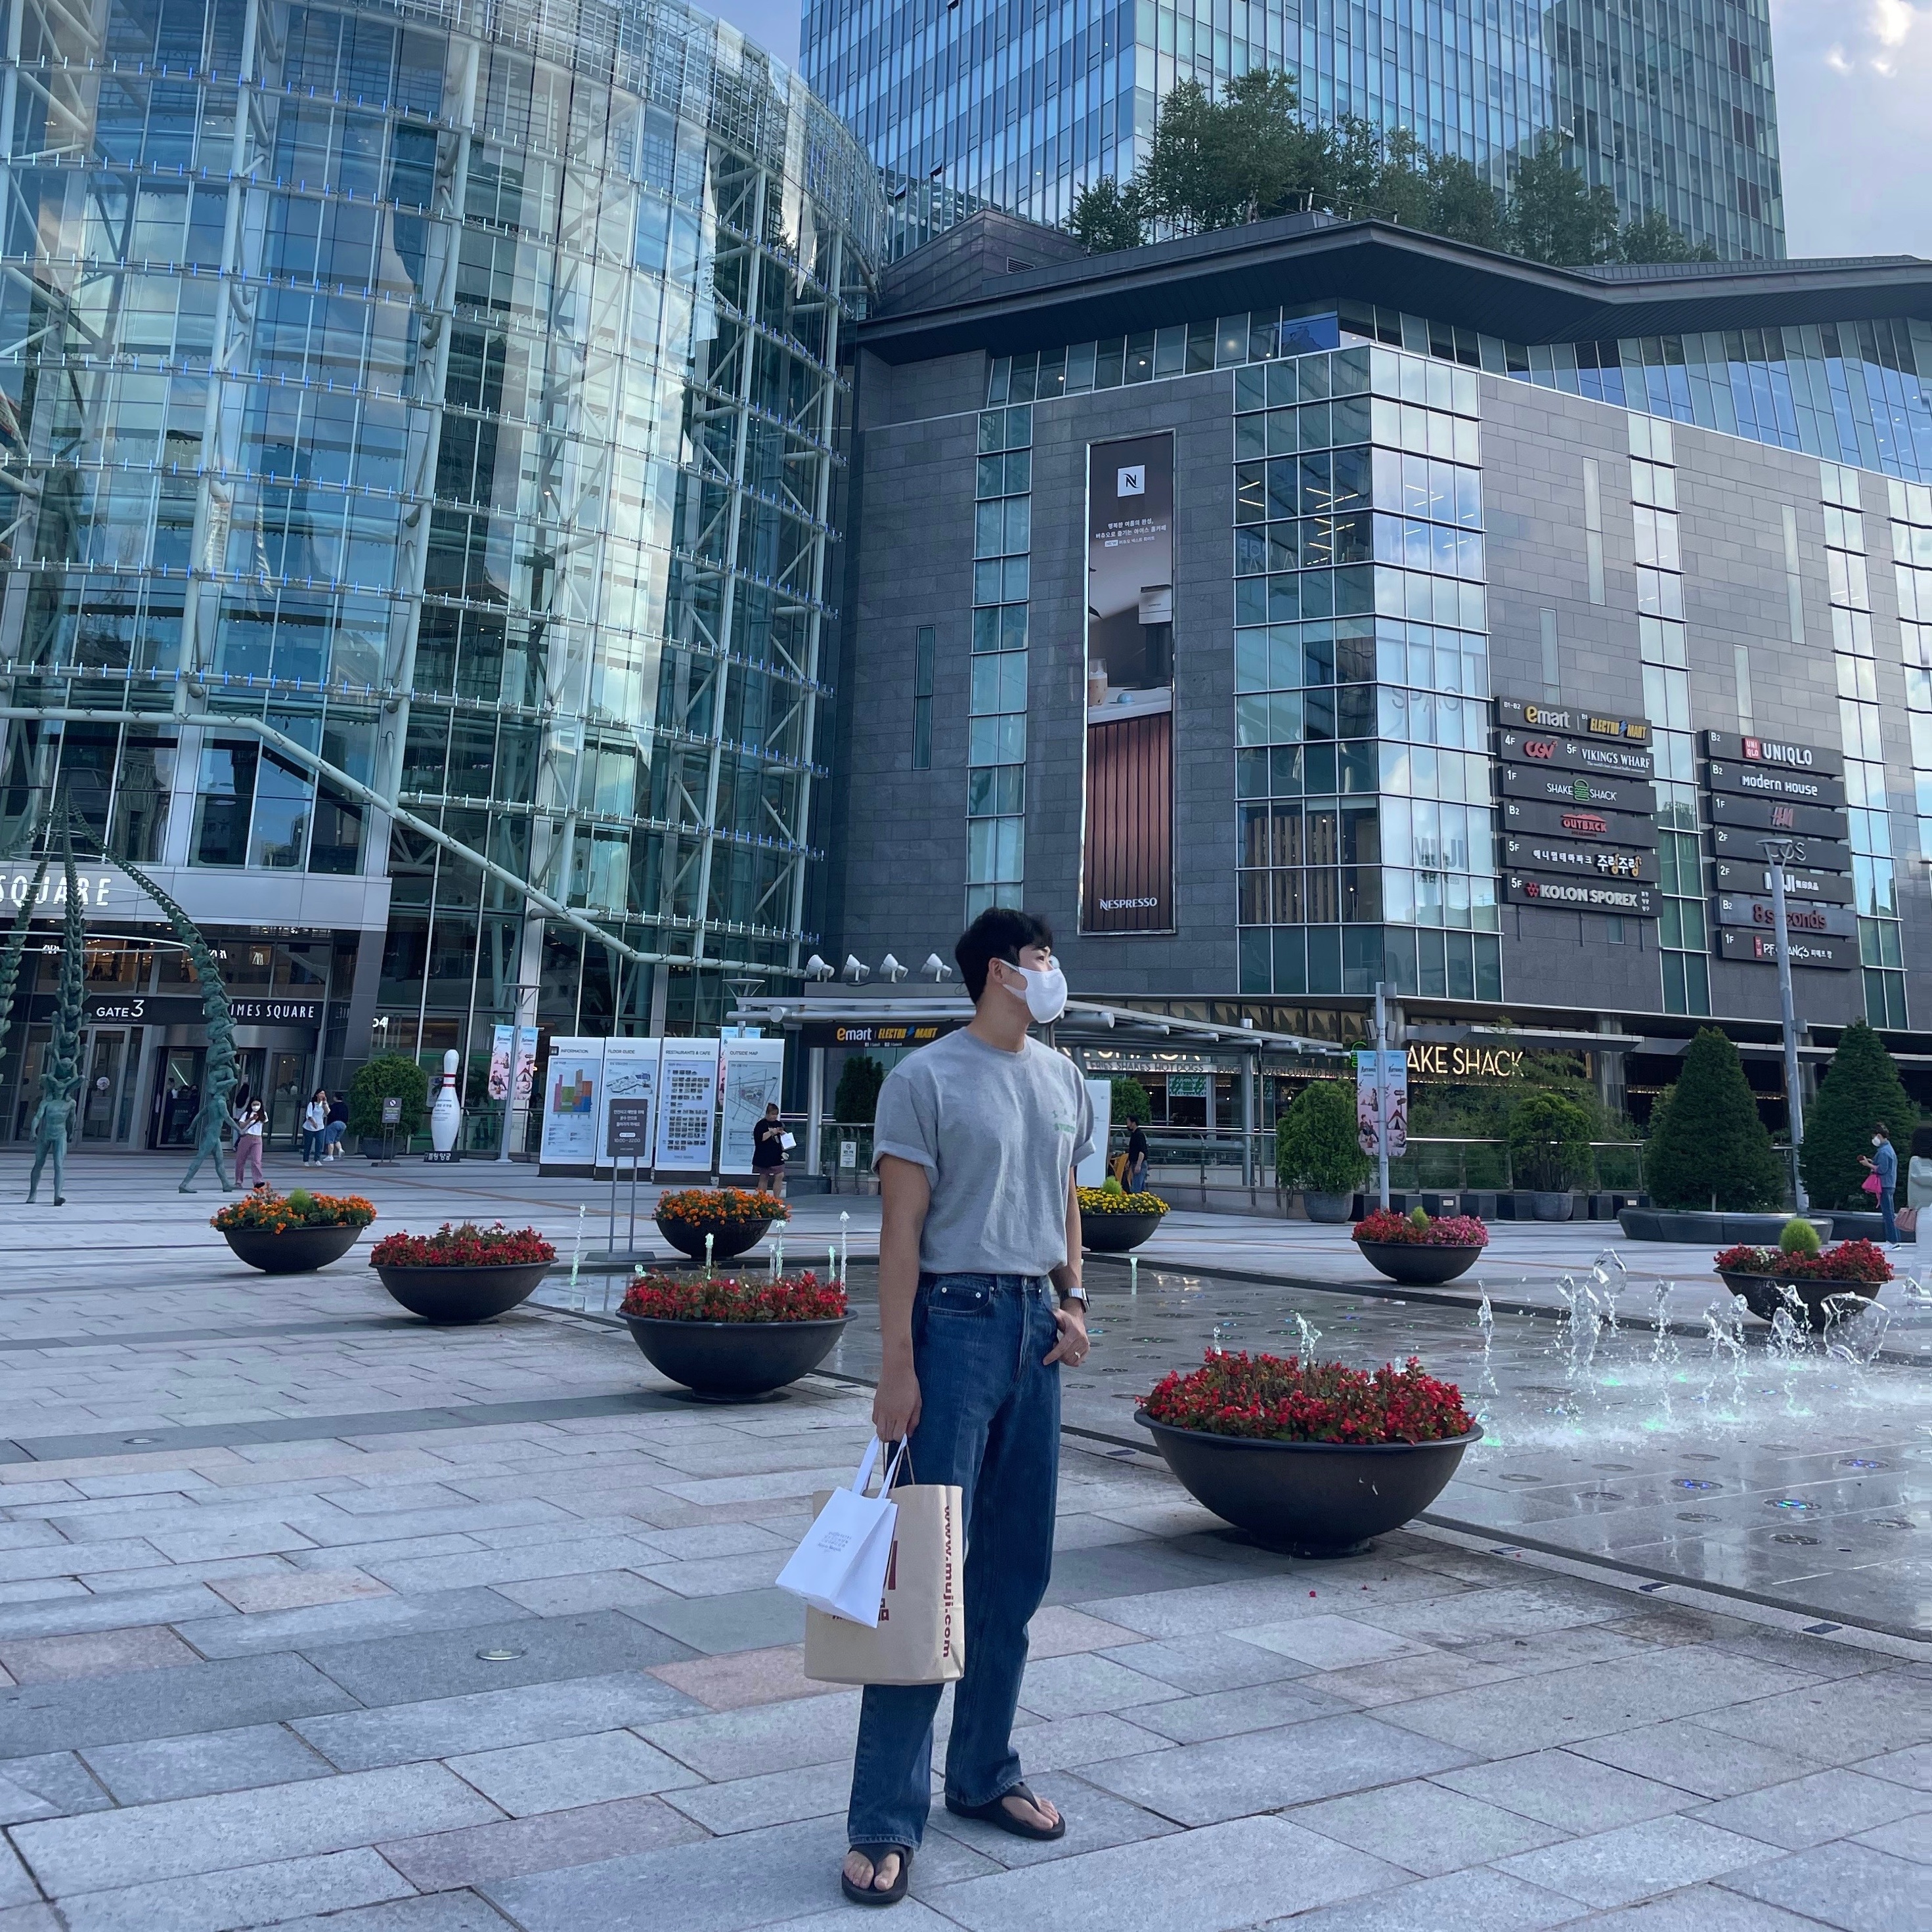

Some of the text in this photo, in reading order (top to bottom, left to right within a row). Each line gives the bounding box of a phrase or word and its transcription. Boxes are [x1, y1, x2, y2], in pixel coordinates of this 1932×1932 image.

[1526, 705, 1571, 728] emart
[1589, 718, 1647, 739] ELECTRO MART
[1504, 735, 1516, 745] 4F
[1711, 732, 1721, 741] B2
[1525, 741, 1556, 758] CGV
[1566, 743, 1577, 754] 5F
[1747, 740, 1757, 749] UNI
[1581, 749, 1619, 764] VIKING'S
[1619, 754, 1650, 768] WHARF
[1747, 749, 1759, 757] QLO
[1762, 743, 1812, 766] UNIQLO
[1507, 770, 1516, 780] 1F
[1713, 765, 1723, 775] B2
[1547, 783, 1617, 801] SHAKE SHACK
[1716, 798, 1725, 808] 1F
[1509, 805, 1520, 815] B2
[1563, 820, 1607, 833] OUTBACK
[1718, 831, 1728, 841] 2F
[1413, 837, 1465, 868] MUJI
[1509, 841, 1520, 852] 5F
[1597, 853, 1642, 877] 주렁주렁
[1720, 865, 1730, 876] 2F
[1511, 877, 1522, 889] 5F
[1763, 872, 1795, 892] MJI
[1539, 885, 1589, 902] KOLON
[1589, 889, 1638, 907] SPOREX
[1098, 897, 1158, 911] NESPRESSO
[1723, 900, 1732, 911] B2
[1725, 933, 1734, 944] 1F
[96, 999, 144, 1018] GATE 3
[231, 1003, 315, 1019] IMES SQUARE
[836, 1027, 872, 1041] emart
[878, 1027, 938, 1040] ELECTRO MART
[1090, 1062, 1204, 1073] FRIES SHAKES HOT DOGS
[1407, 1045, 1524, 1078] AKE SHACK
[1287, 1066, 1322, 1077] CUSTARD
[943, 1505, 954, 1658] www.muji.com
